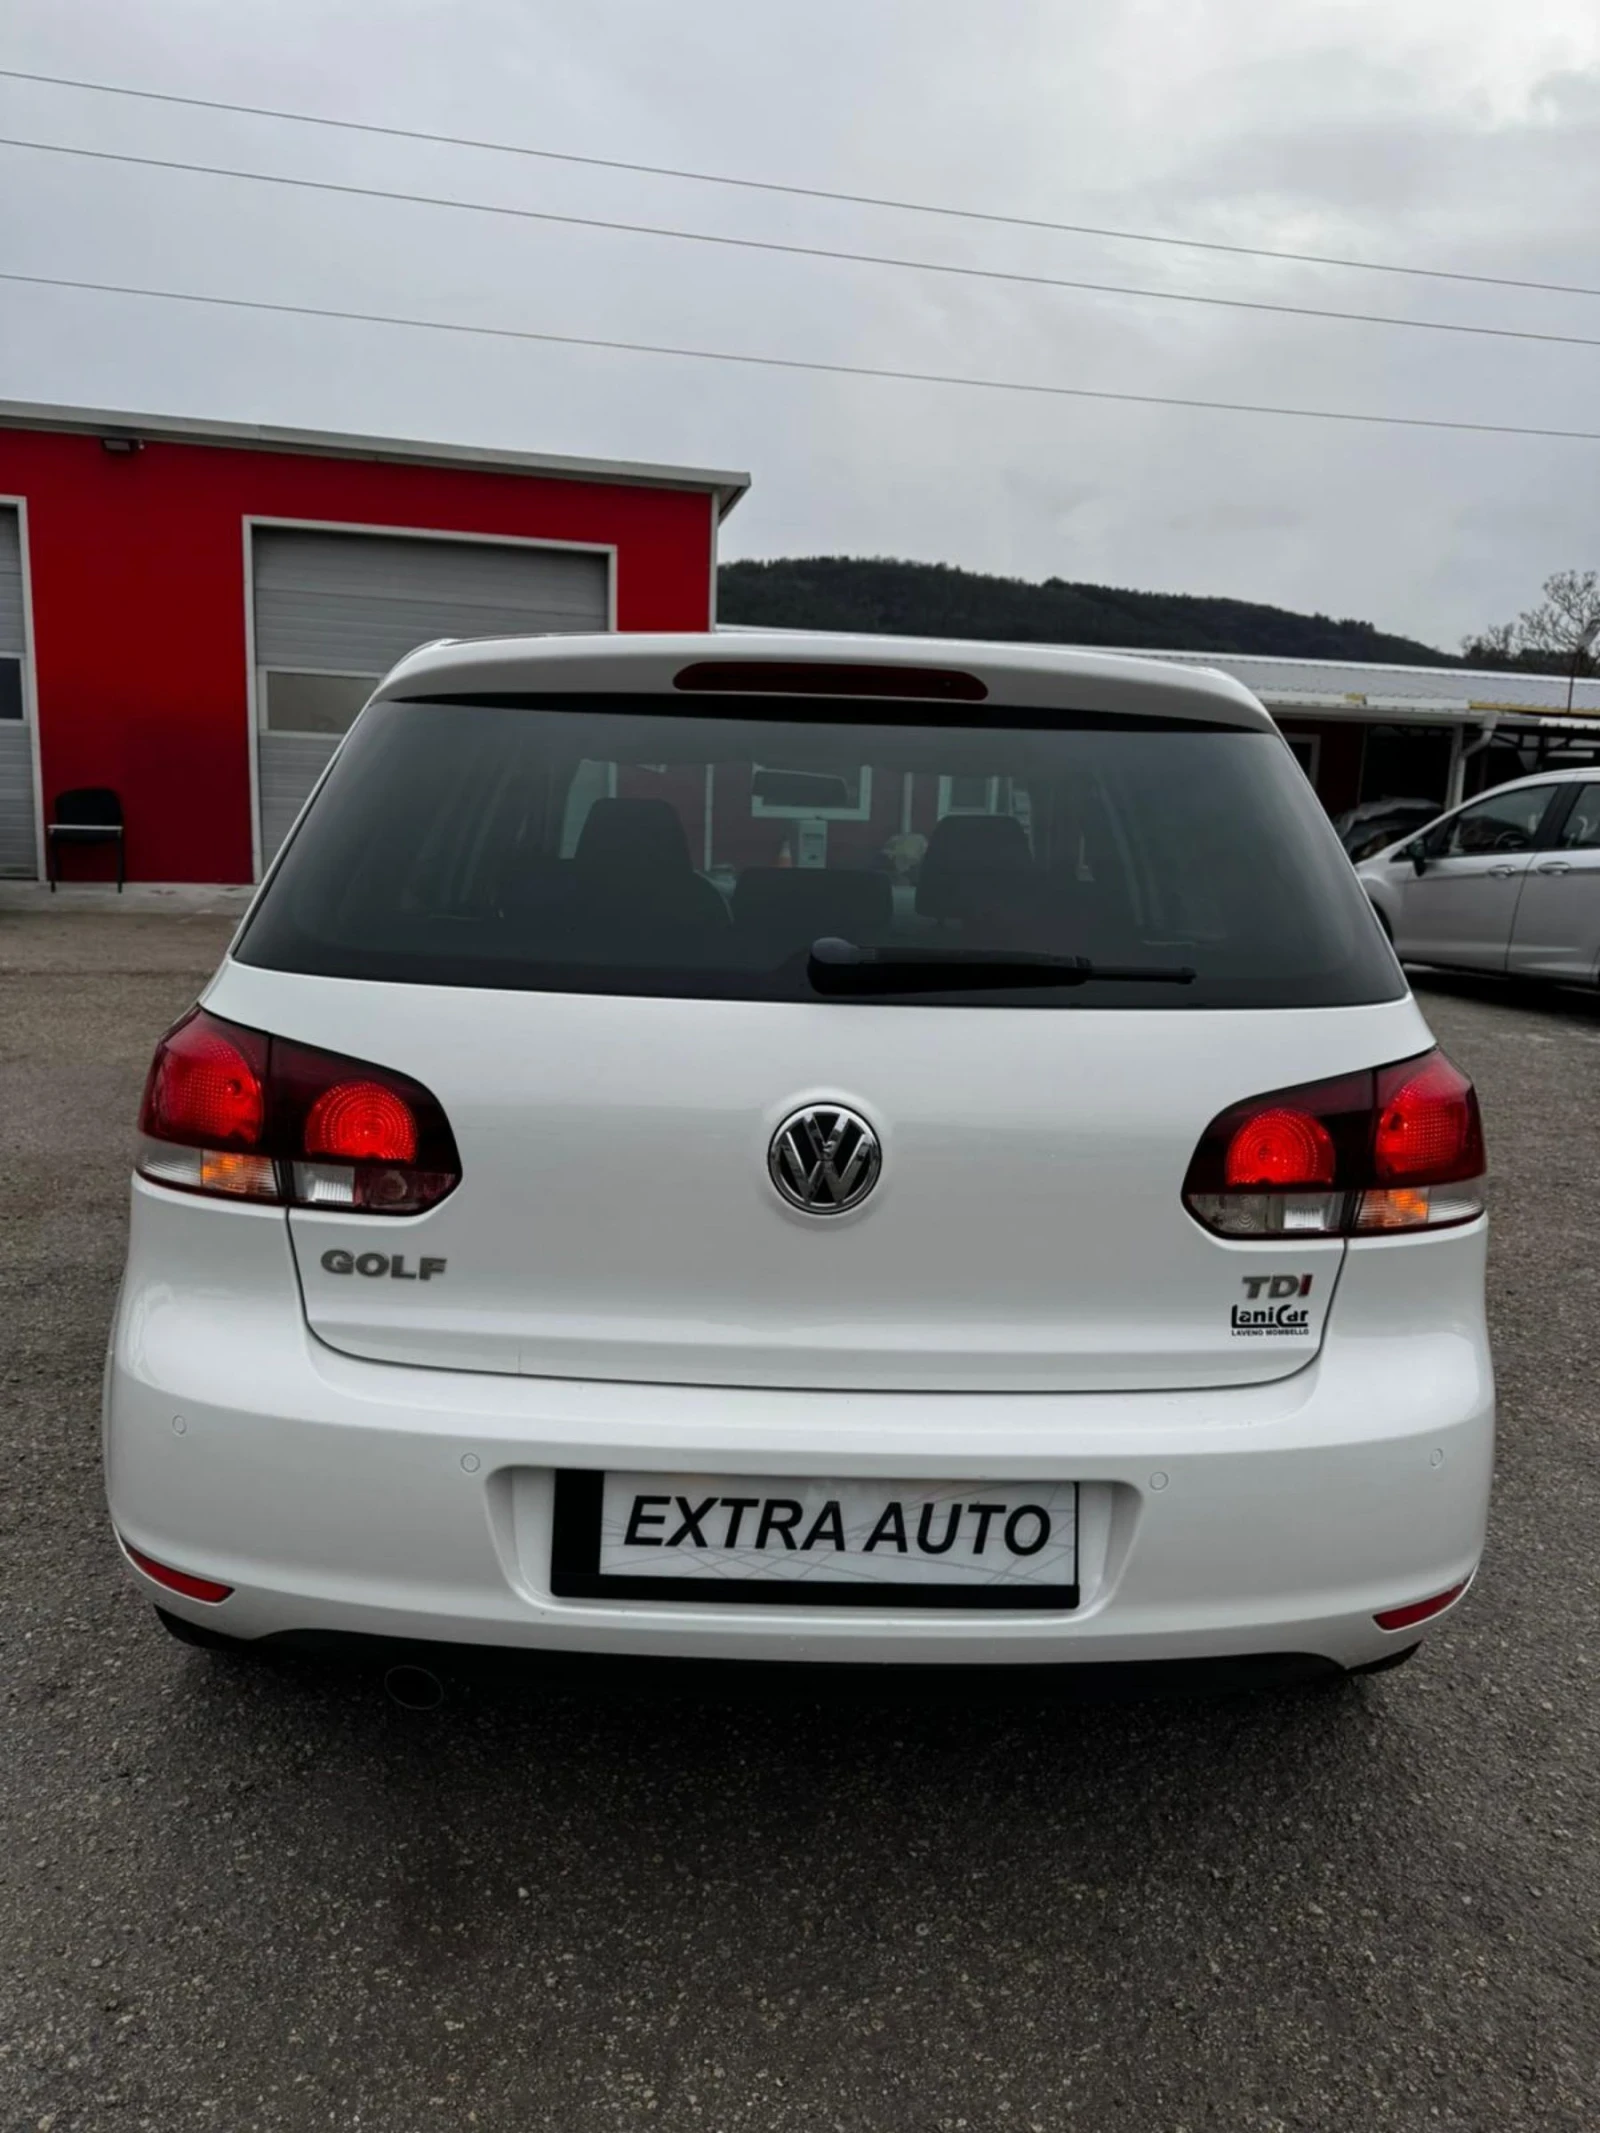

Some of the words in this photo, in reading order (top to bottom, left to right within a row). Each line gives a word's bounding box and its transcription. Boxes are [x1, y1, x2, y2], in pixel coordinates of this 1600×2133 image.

[773, 1106, 878, 1211] VW
[320, 1249, 447, 1281] GOLF
[1242, 1273, 1313, 1299] TDI
[1231, 1304, 1309, 1328] LaniCar
[1231, 1329, 1264, 1337] LAVENO
[1265, 1328, 1310, 1336] MOMBELLO
[623, 1495, 846, 1552] EXTRA
[862, 1501, 1051, 1557] AUTO
